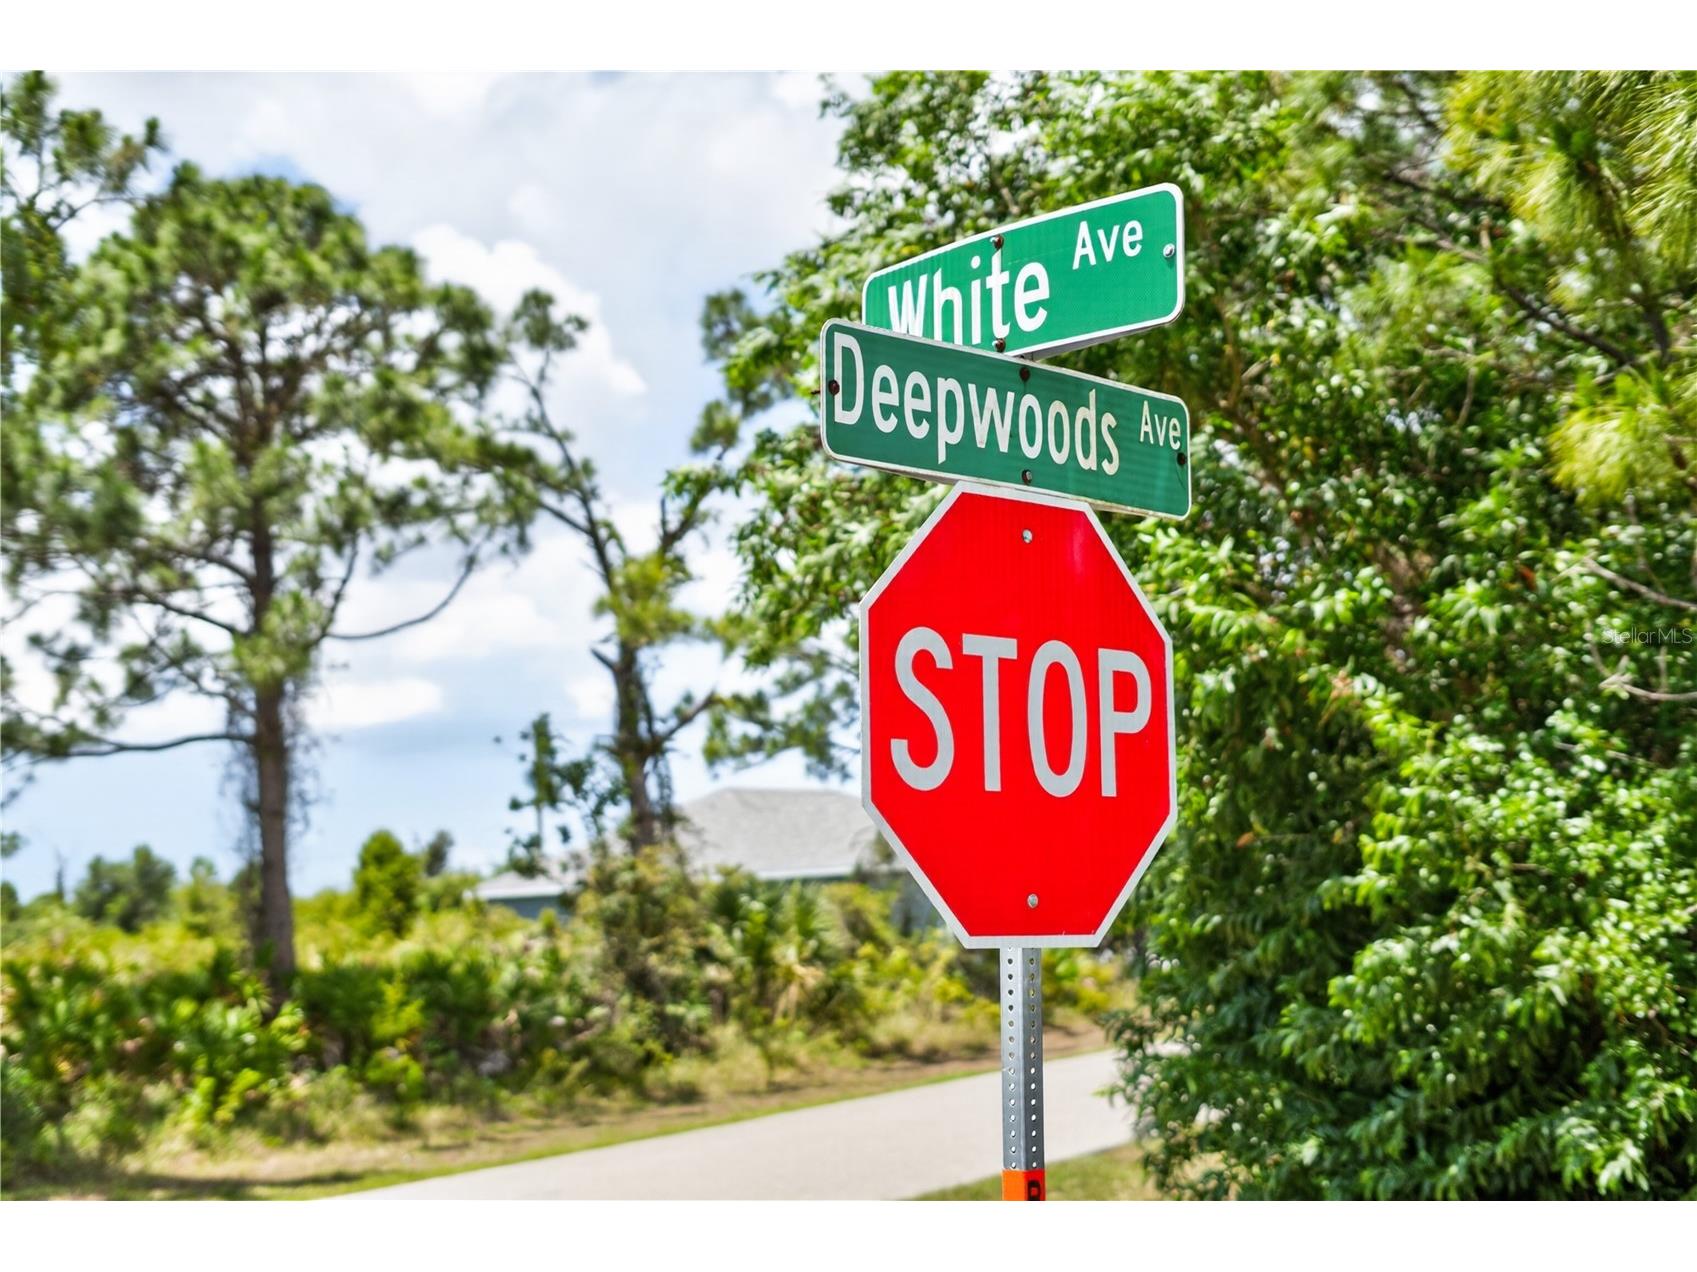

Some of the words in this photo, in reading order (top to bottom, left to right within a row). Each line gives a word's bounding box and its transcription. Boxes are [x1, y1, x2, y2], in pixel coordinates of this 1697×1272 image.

[888, 250, 1050, 346] White
[1073, 218, 1143, 271] Ave
[834, 332, 1120, 475] Deepwoods
[1139, 400, 1181, 450] Ave
[890, 626, 1152, 798] STOP
